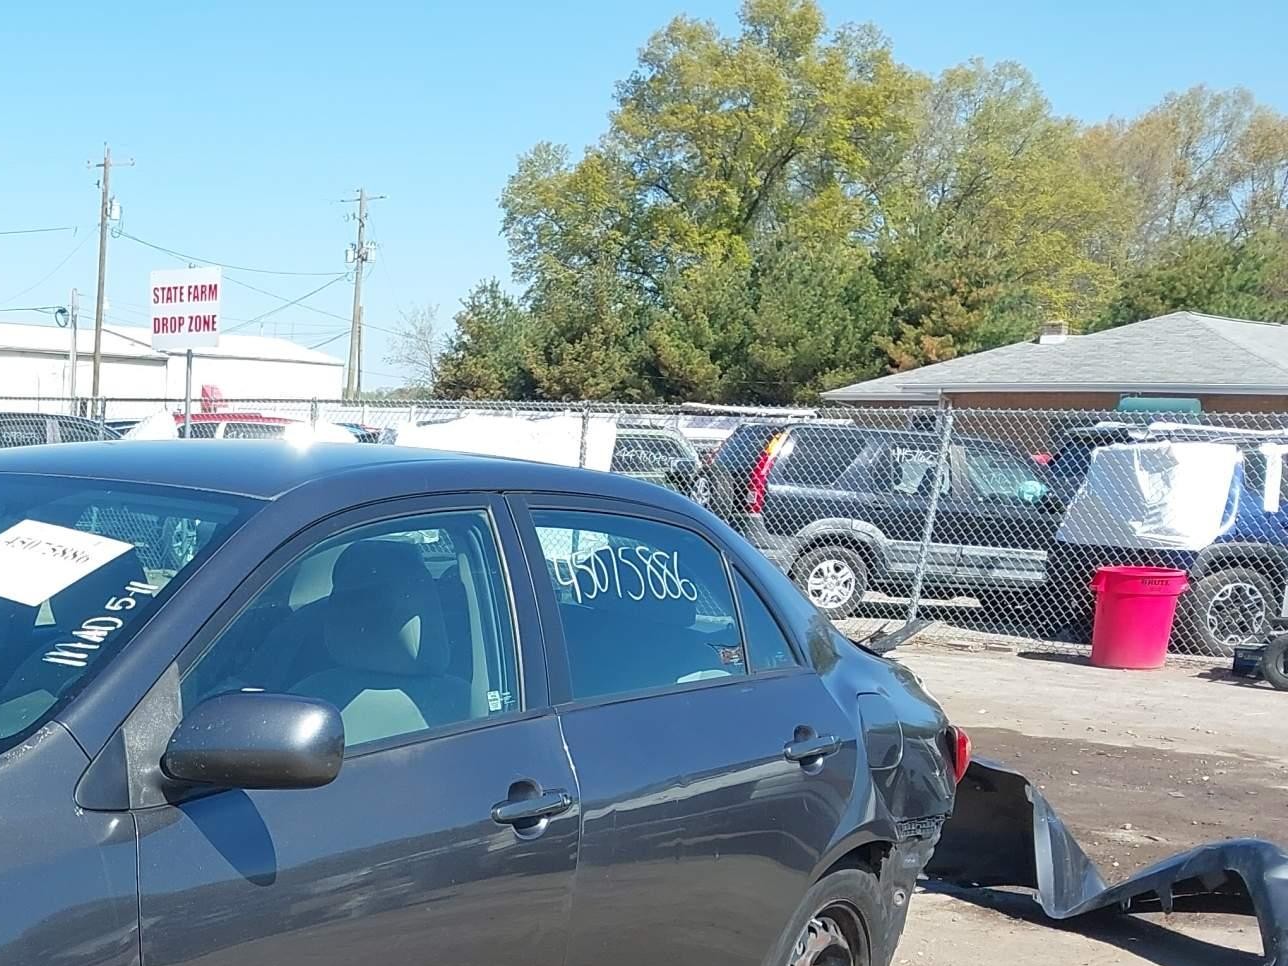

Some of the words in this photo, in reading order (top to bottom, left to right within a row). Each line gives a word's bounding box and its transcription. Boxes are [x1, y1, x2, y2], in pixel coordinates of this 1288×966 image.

[153, 286, 184, 304] STATE
[187, 284, 218, 302] FARM
[153, 316, 184, 334] DROP
[187, 315, 217, 332] ZONE
[554, 545, 698, 603] 45075886
